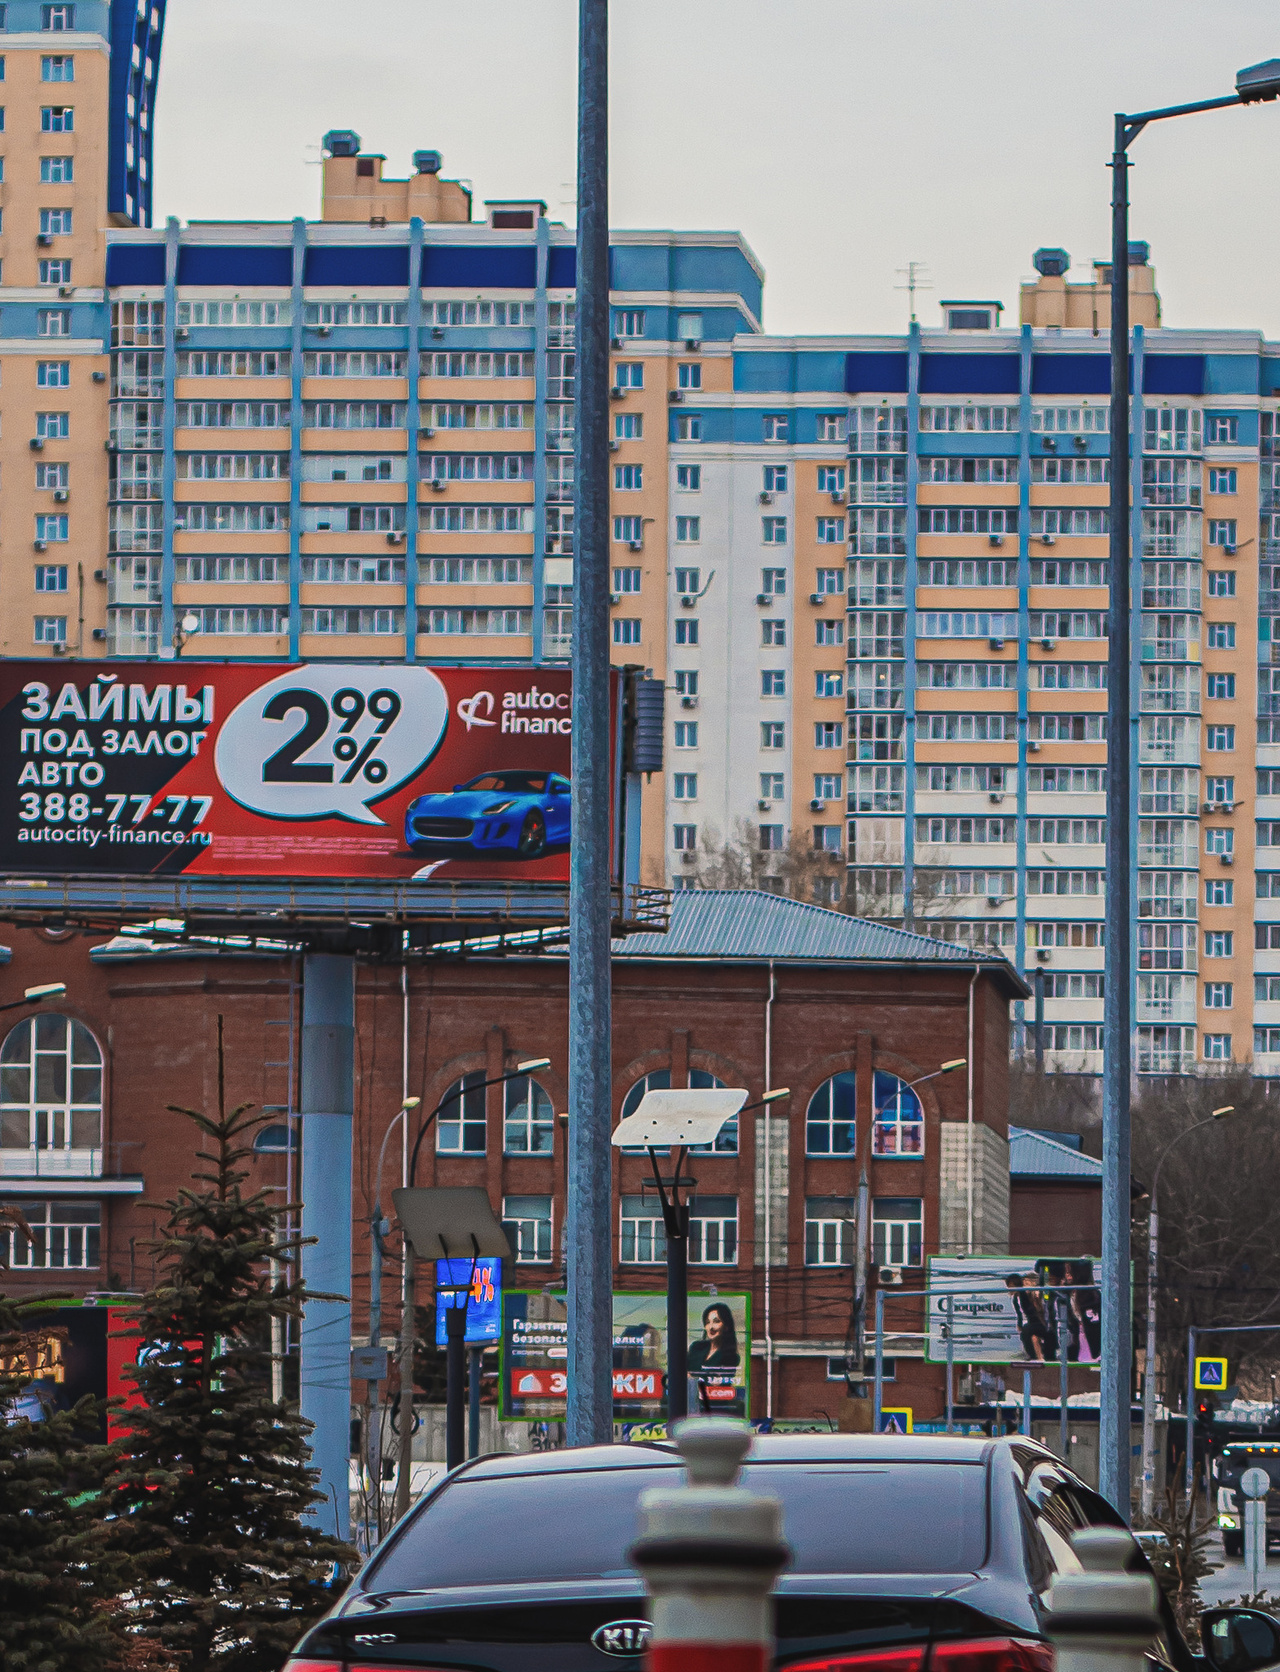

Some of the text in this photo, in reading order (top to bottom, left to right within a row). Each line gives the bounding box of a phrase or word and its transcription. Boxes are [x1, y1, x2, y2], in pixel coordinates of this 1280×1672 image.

[21, 673, 215, 724] ЗАЙМЫ
[501, 686, 571, 710] autoc
[501, 710, 572, 735] financ
[20, 728, 208, 758] ПОД ЗАЛОГ
[17, 761, 106, 787] АВТО
[18, 792, 214, 825] 388-77-77
[17, 824, 213, 848] autocity-finance.ru
